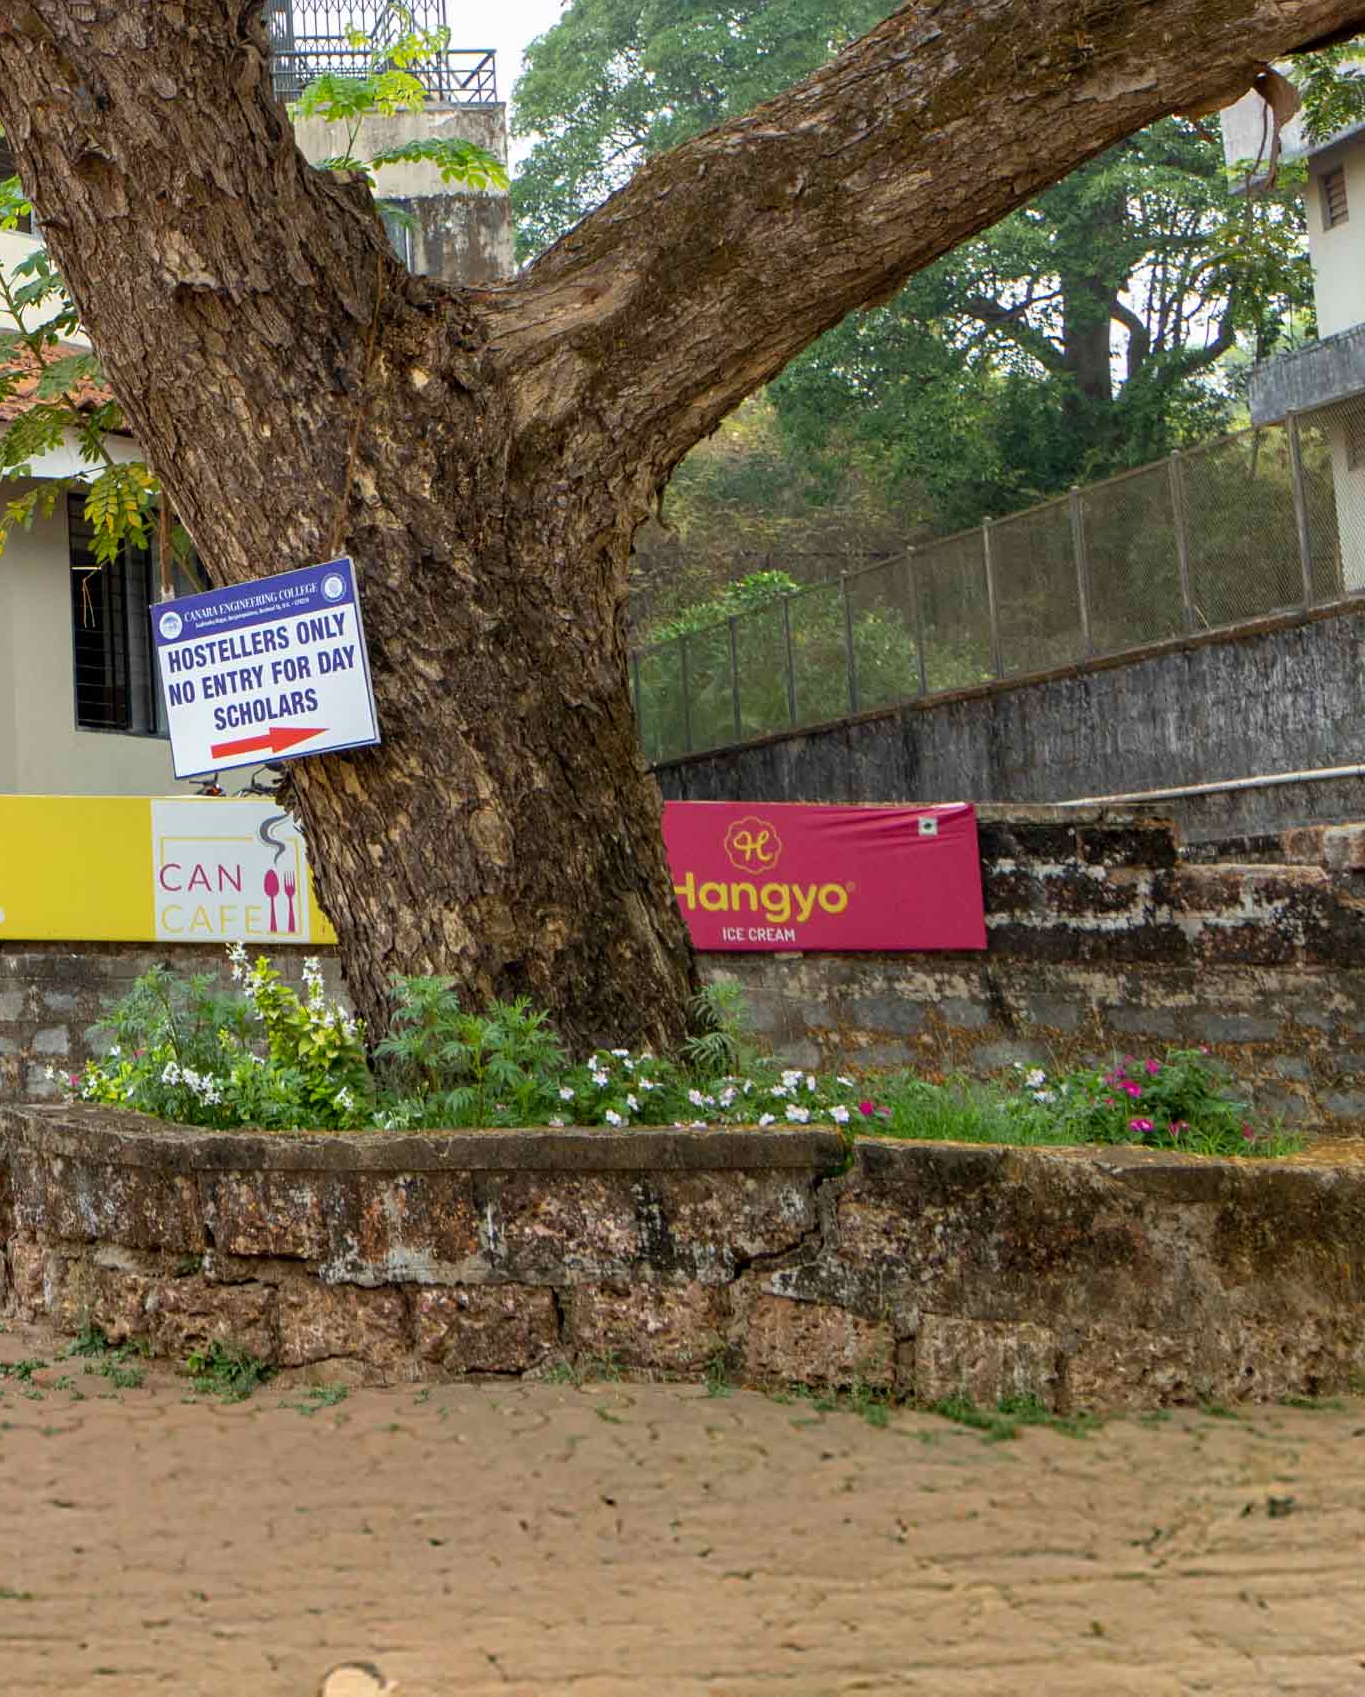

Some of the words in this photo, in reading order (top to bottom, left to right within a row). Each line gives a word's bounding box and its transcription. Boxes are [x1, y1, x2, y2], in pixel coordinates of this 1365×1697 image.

[184, 605, 218, 623] CANARA
[219, 592, 278, 614] ENGINEERING
[278, 582, 318, 603] COLLEGE
[167, 625, 290, 673] HOSTELLERS
[296, 612, 346, 645] ONLY
[168, 679, 196, 707] NO
[203, 664, 264, 699] ENTRY
[271, 655, 312, 685] FOR
[317, 645, 355, 675] DAY
[213, 688, 318, 731] SCHOLARS
[159, 863, 242, 892] CAN
[161, 904, 263, 935] CAFE
[722, 926, 745, 942] ICE
[748, 927, 796, 943] CREAM
